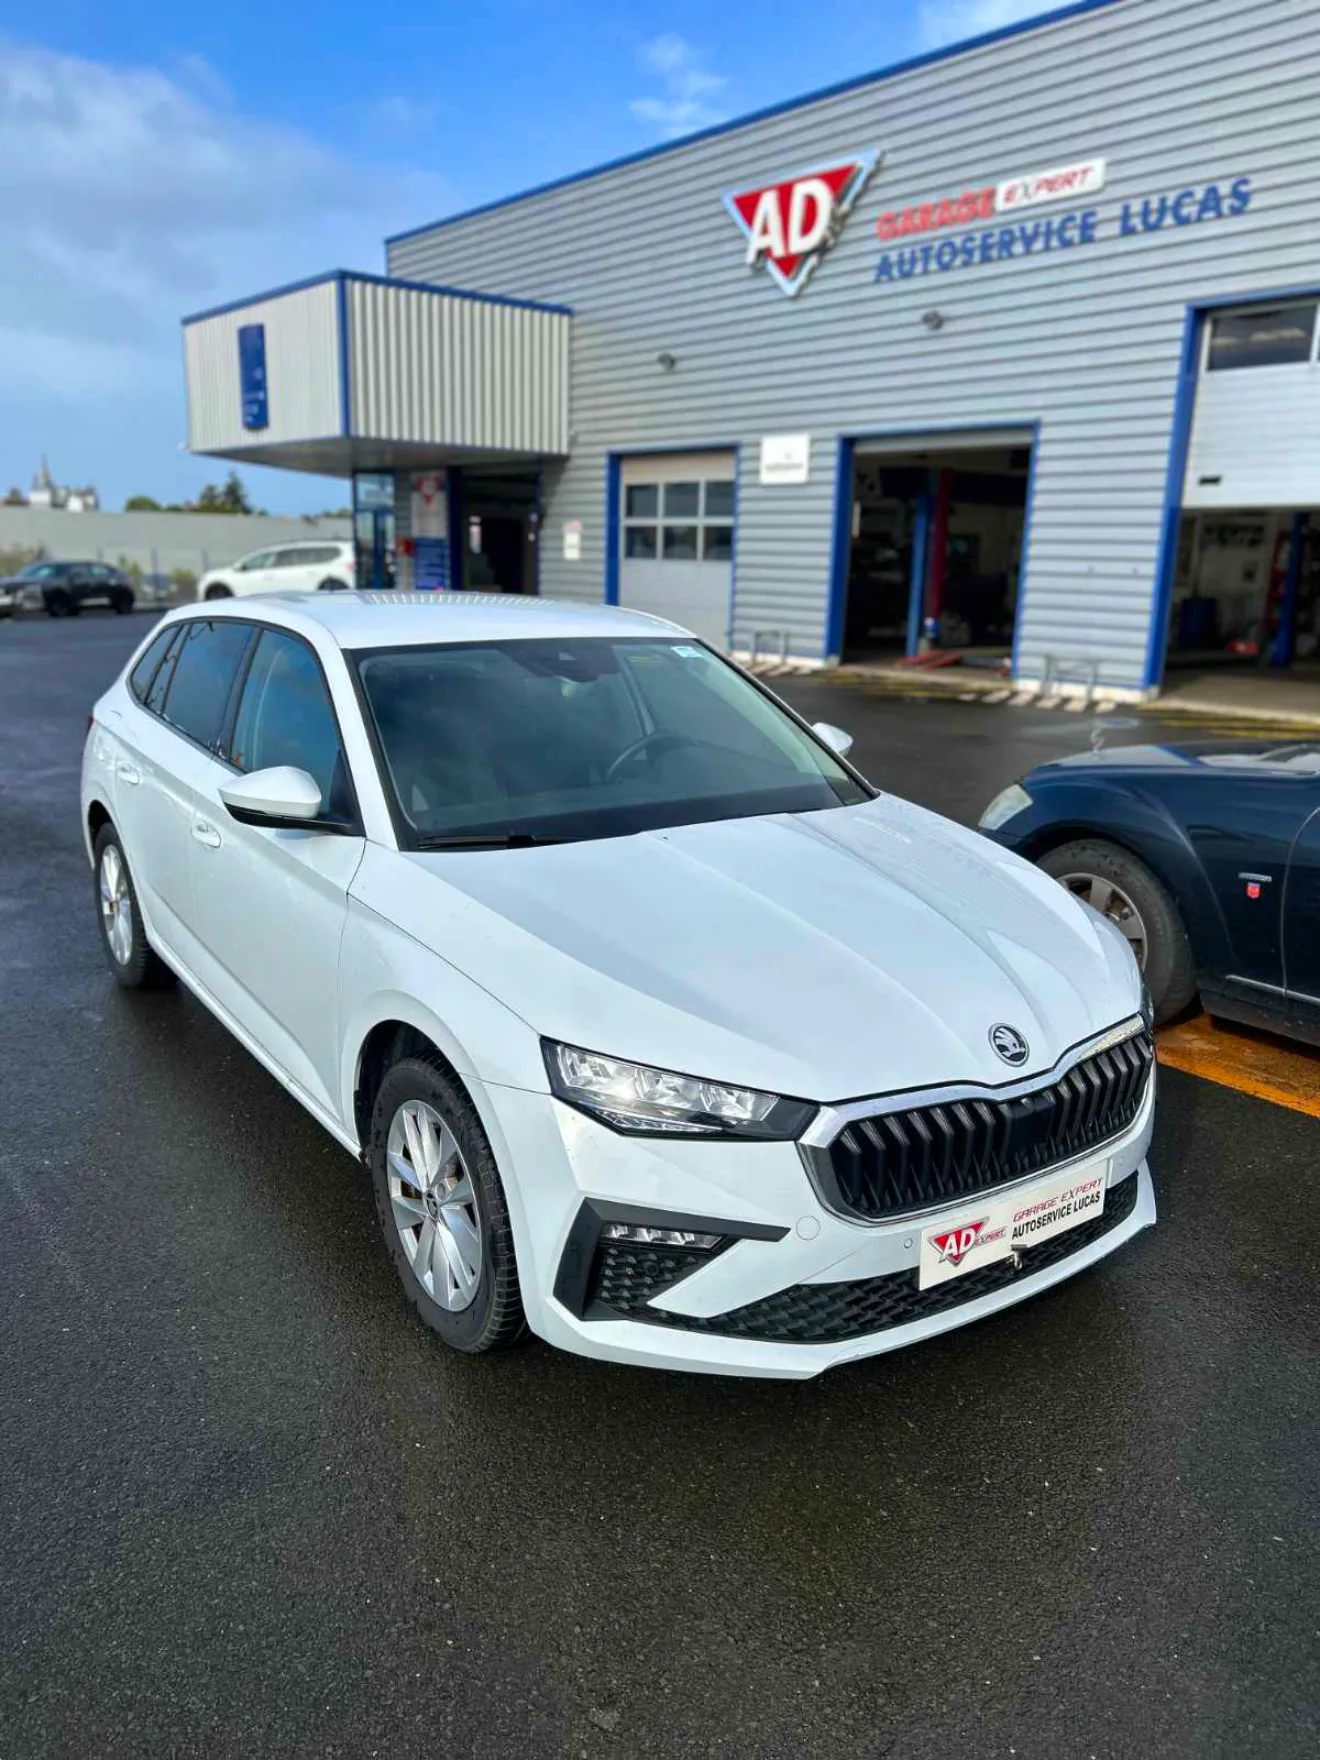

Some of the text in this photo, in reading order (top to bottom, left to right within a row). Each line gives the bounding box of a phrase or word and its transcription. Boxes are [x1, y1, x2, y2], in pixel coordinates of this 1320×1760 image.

[746, 178, 832, 264] AD
[873, 177, 1250, 283] AUTOSERVICE LUCAS
[876, 166, 1092, 241] GARAGE EXPERT
[1012, 1191, 1101, 1240] AUTOSERVICE LUCAS
[1013, 1178, 1103, 1222] GARAGE EXPERT
[940, 1227, 976, 1261] AD
